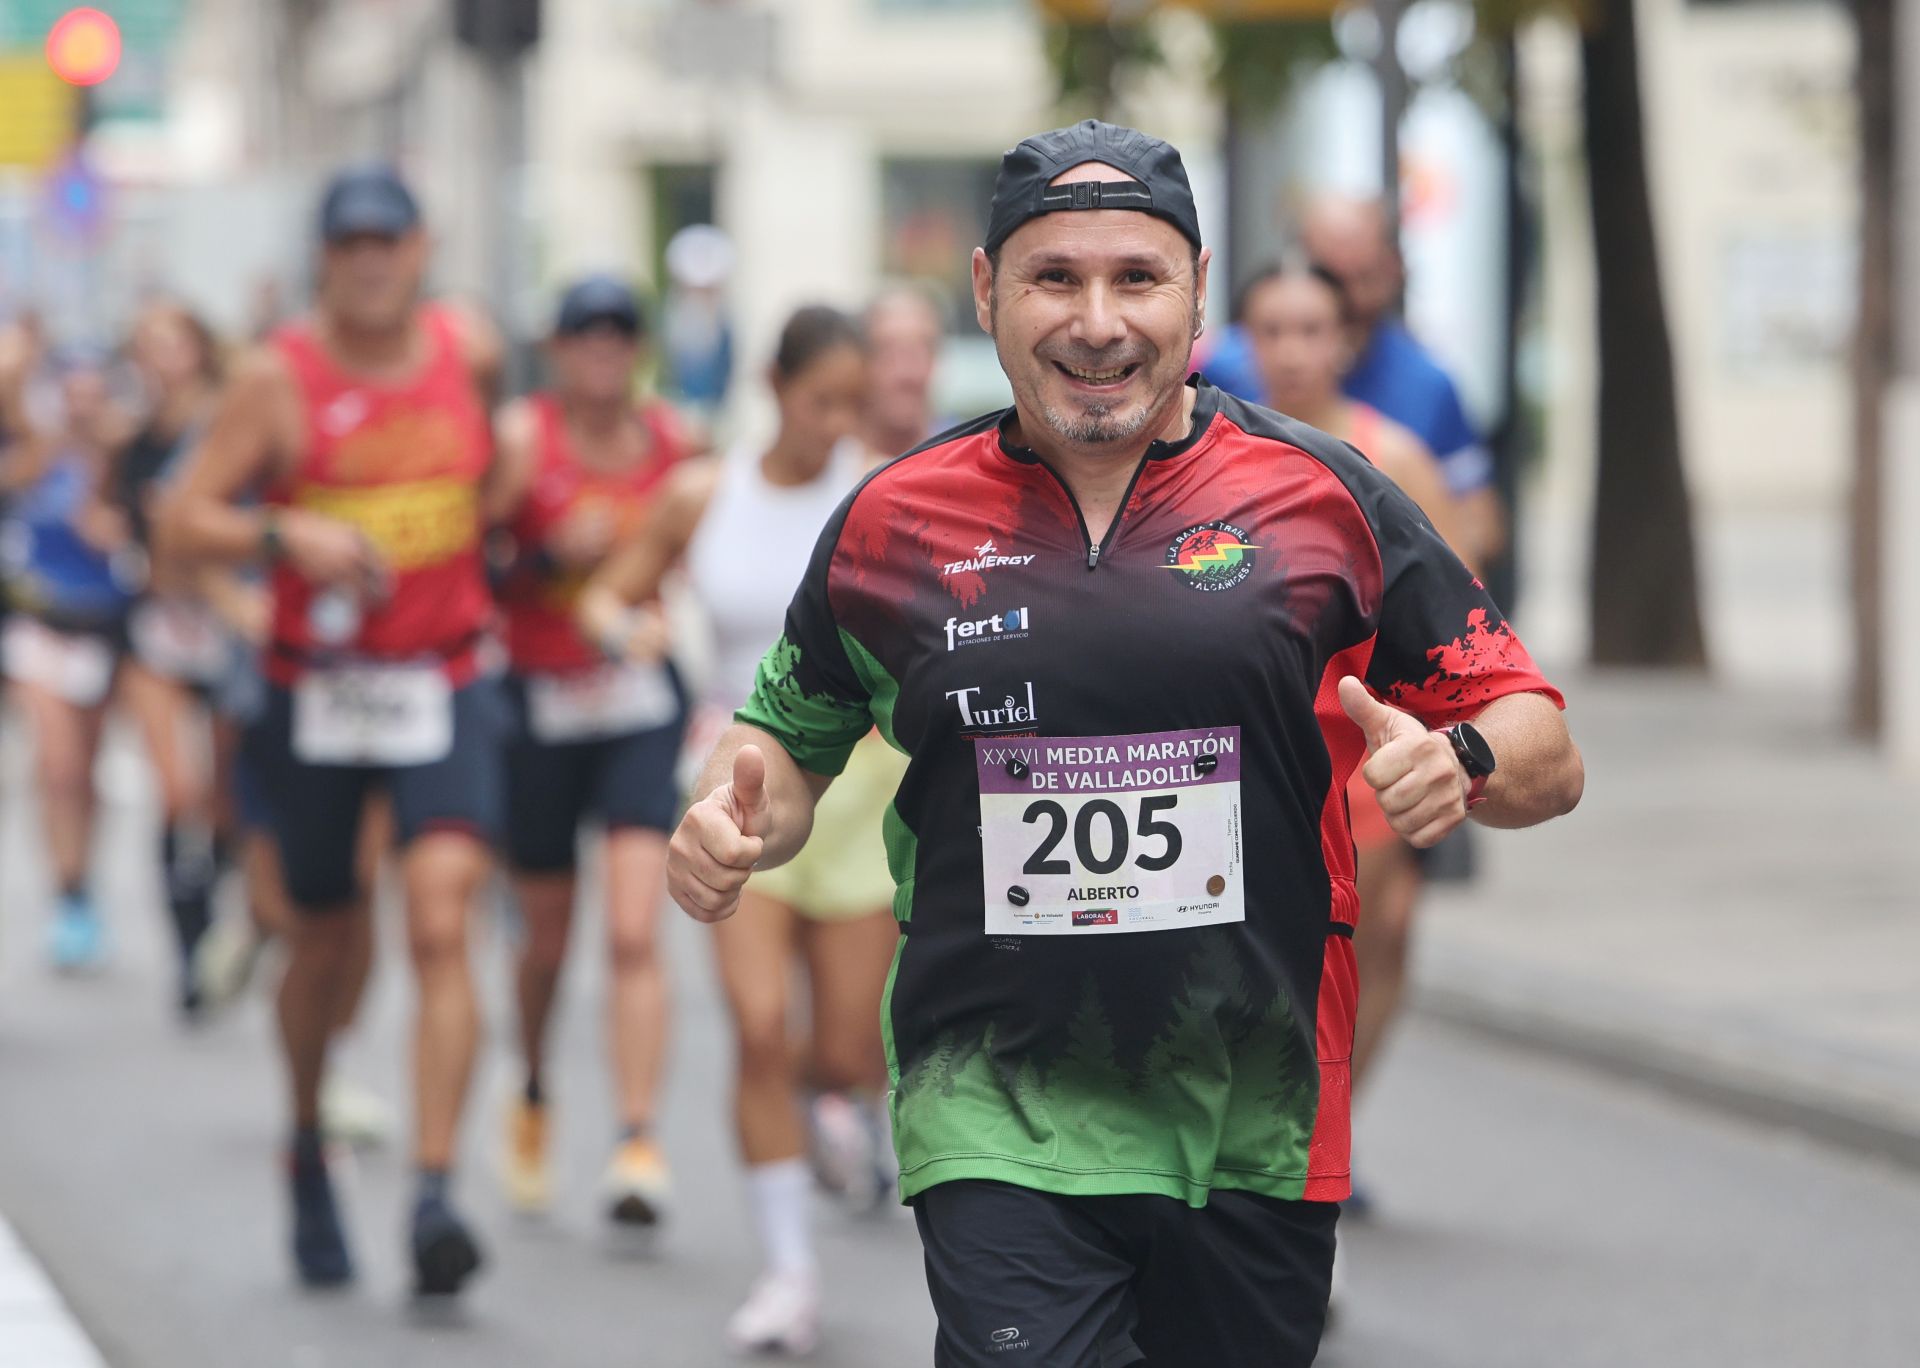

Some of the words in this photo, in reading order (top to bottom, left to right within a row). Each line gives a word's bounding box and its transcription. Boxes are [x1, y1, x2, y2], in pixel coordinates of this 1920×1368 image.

[1168, 546, 1179, 558] LA
[1219, 522, 1246, 540] TRAIL
[943, 554, 1036, 576] TEAMERGY
[945, 681, 1038, 727] Turiel
[982, 748, 1039, 765] XXXVI
[1046, 747, 1120, 765] MEDIA
[1127, 732, 1234, 762] MARATÓN
[1031, 771, 1059, 789] DE
[1022, 794, 1183, 875] 205
[1067, 885, 1140, 901] ALBERTO
[1189, 903, 1220, 911] HYUNDAI
